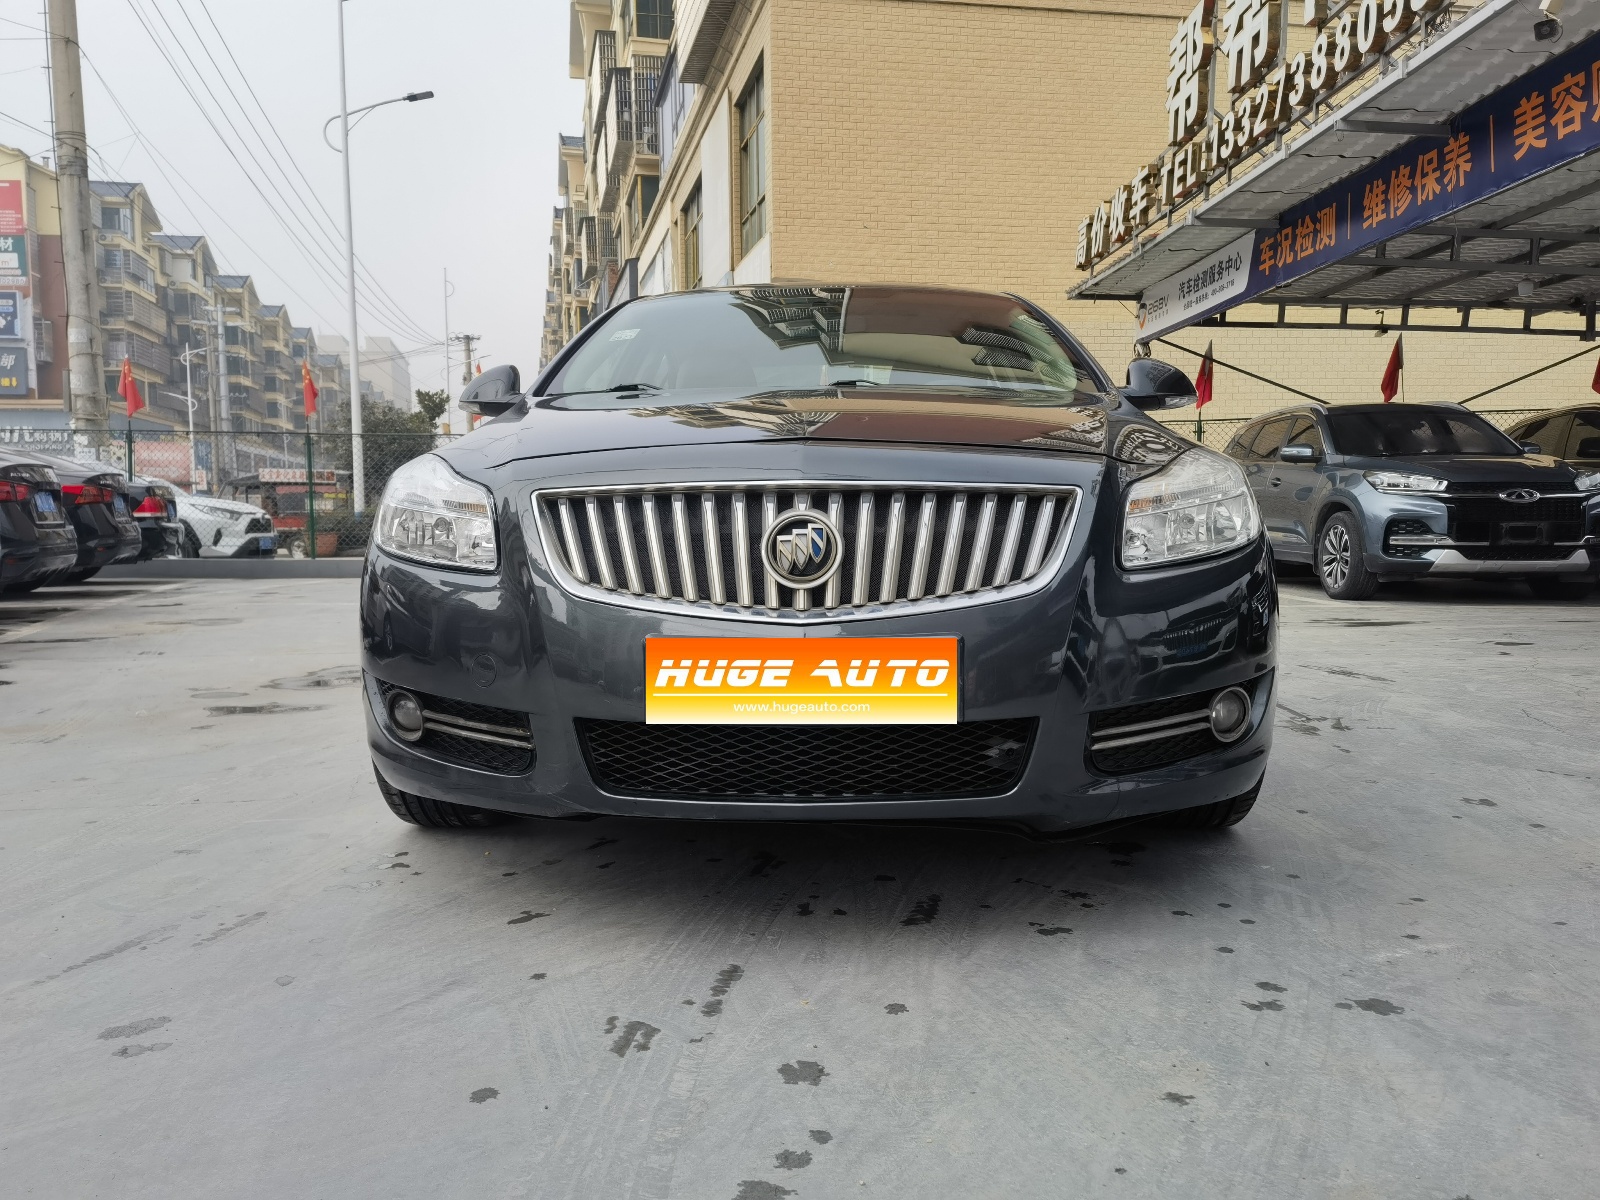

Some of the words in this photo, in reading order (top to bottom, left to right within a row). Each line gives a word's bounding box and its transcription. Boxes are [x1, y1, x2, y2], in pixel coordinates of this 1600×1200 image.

[1165, 0, 1320, 146] 帮帮
[1075, 165, 1154, 269] 高价收车
[1258, 203, 1337, 276] 车况检测
[1362, 133, 1473, 230] 维修保养
[1178, 251, 1243, 301] 汽车检测服务中心
